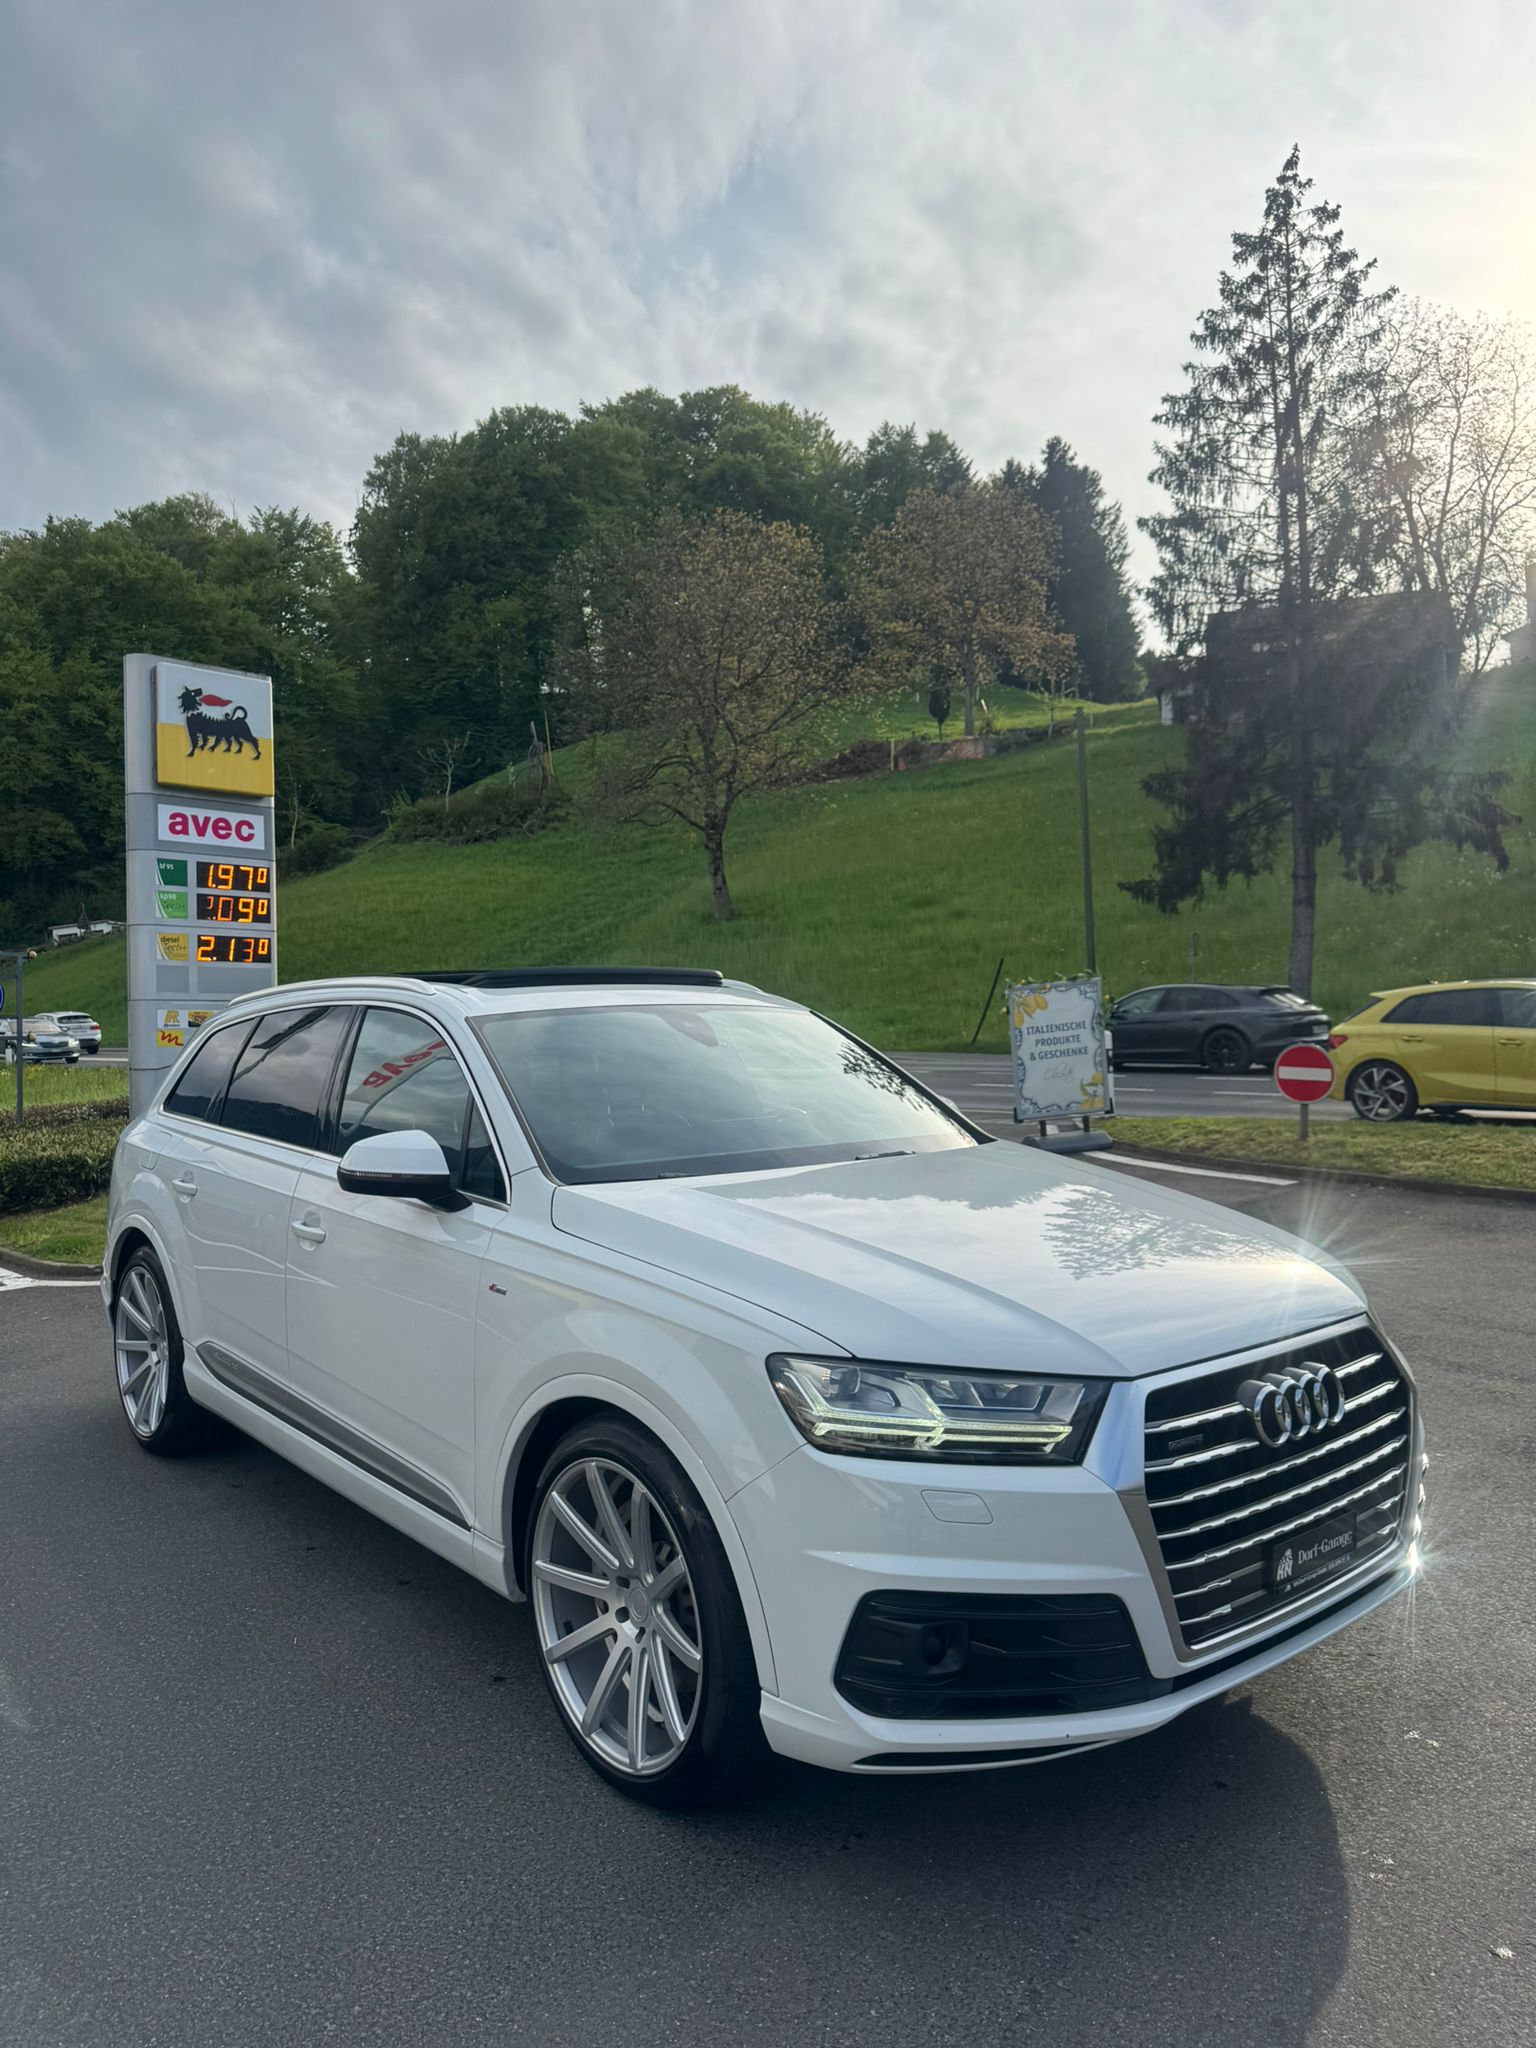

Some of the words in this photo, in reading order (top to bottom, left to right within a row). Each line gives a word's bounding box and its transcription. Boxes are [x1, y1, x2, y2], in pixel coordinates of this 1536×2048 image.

[168, 812, 255, 842] avec
[1026, 1020, 1087, 1035] ITALIENISCHE
[1035, 1034, 1081, 1047] PRODUKTE
[1030, 1053, 1037, 1061] &
[1038, 1046, 1089, 1060] GESCHENKE
[1298, 1531, 1352, 1565] Dorf-Garage
